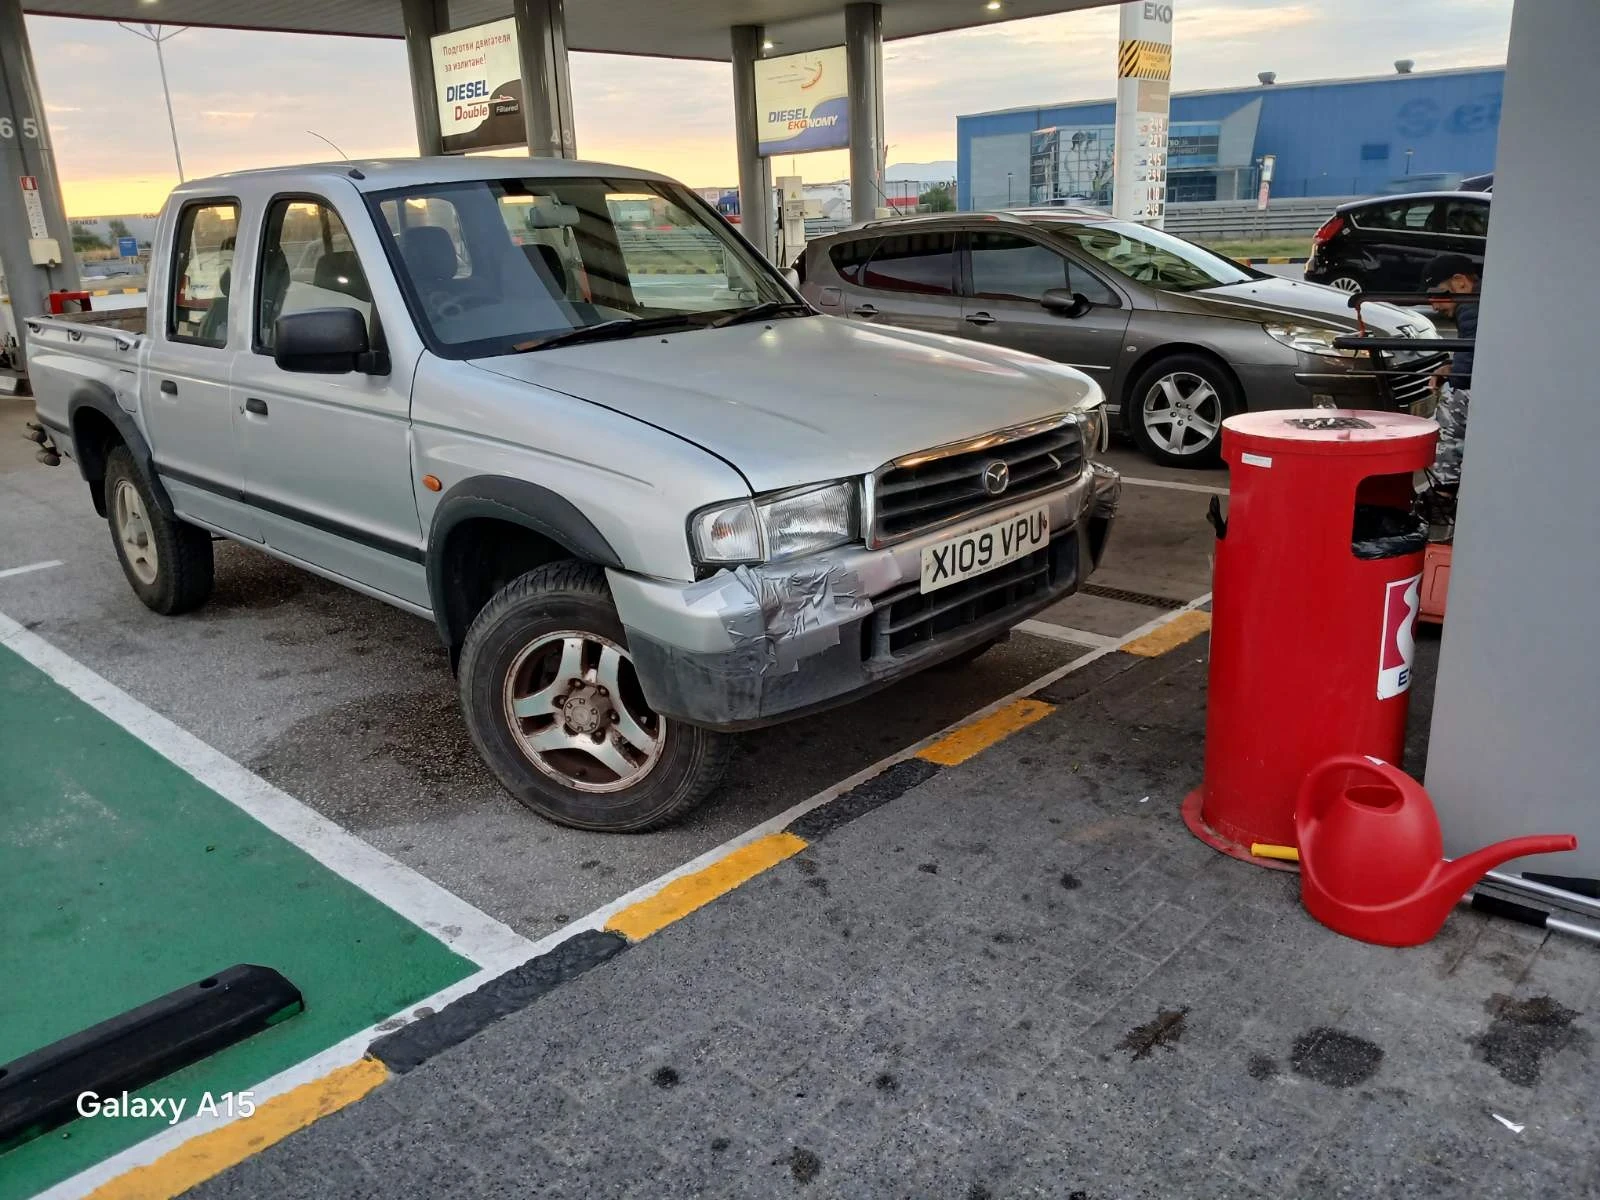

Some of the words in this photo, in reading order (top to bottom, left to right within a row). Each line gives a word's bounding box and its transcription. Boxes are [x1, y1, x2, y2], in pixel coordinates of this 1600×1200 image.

[1144, 2, 1173, 23] EKO
[443, 43, 474, 57] Подготви
[444, 64, 452, 72] за
[446, 80, 489, 103] DIESEL
[455, 103, 488, 121] Double
[496, 103, 519, 113] Filtered
[768, 107, 809, 123] DIESEL
[0, 117, 14, 139] 6
[23, 118, 39, 138] 5
[787, 115, 839, 130] EKONOMY
[931, 533, 993, 583] X109
[1001, 511, 1042, 557] VPU
